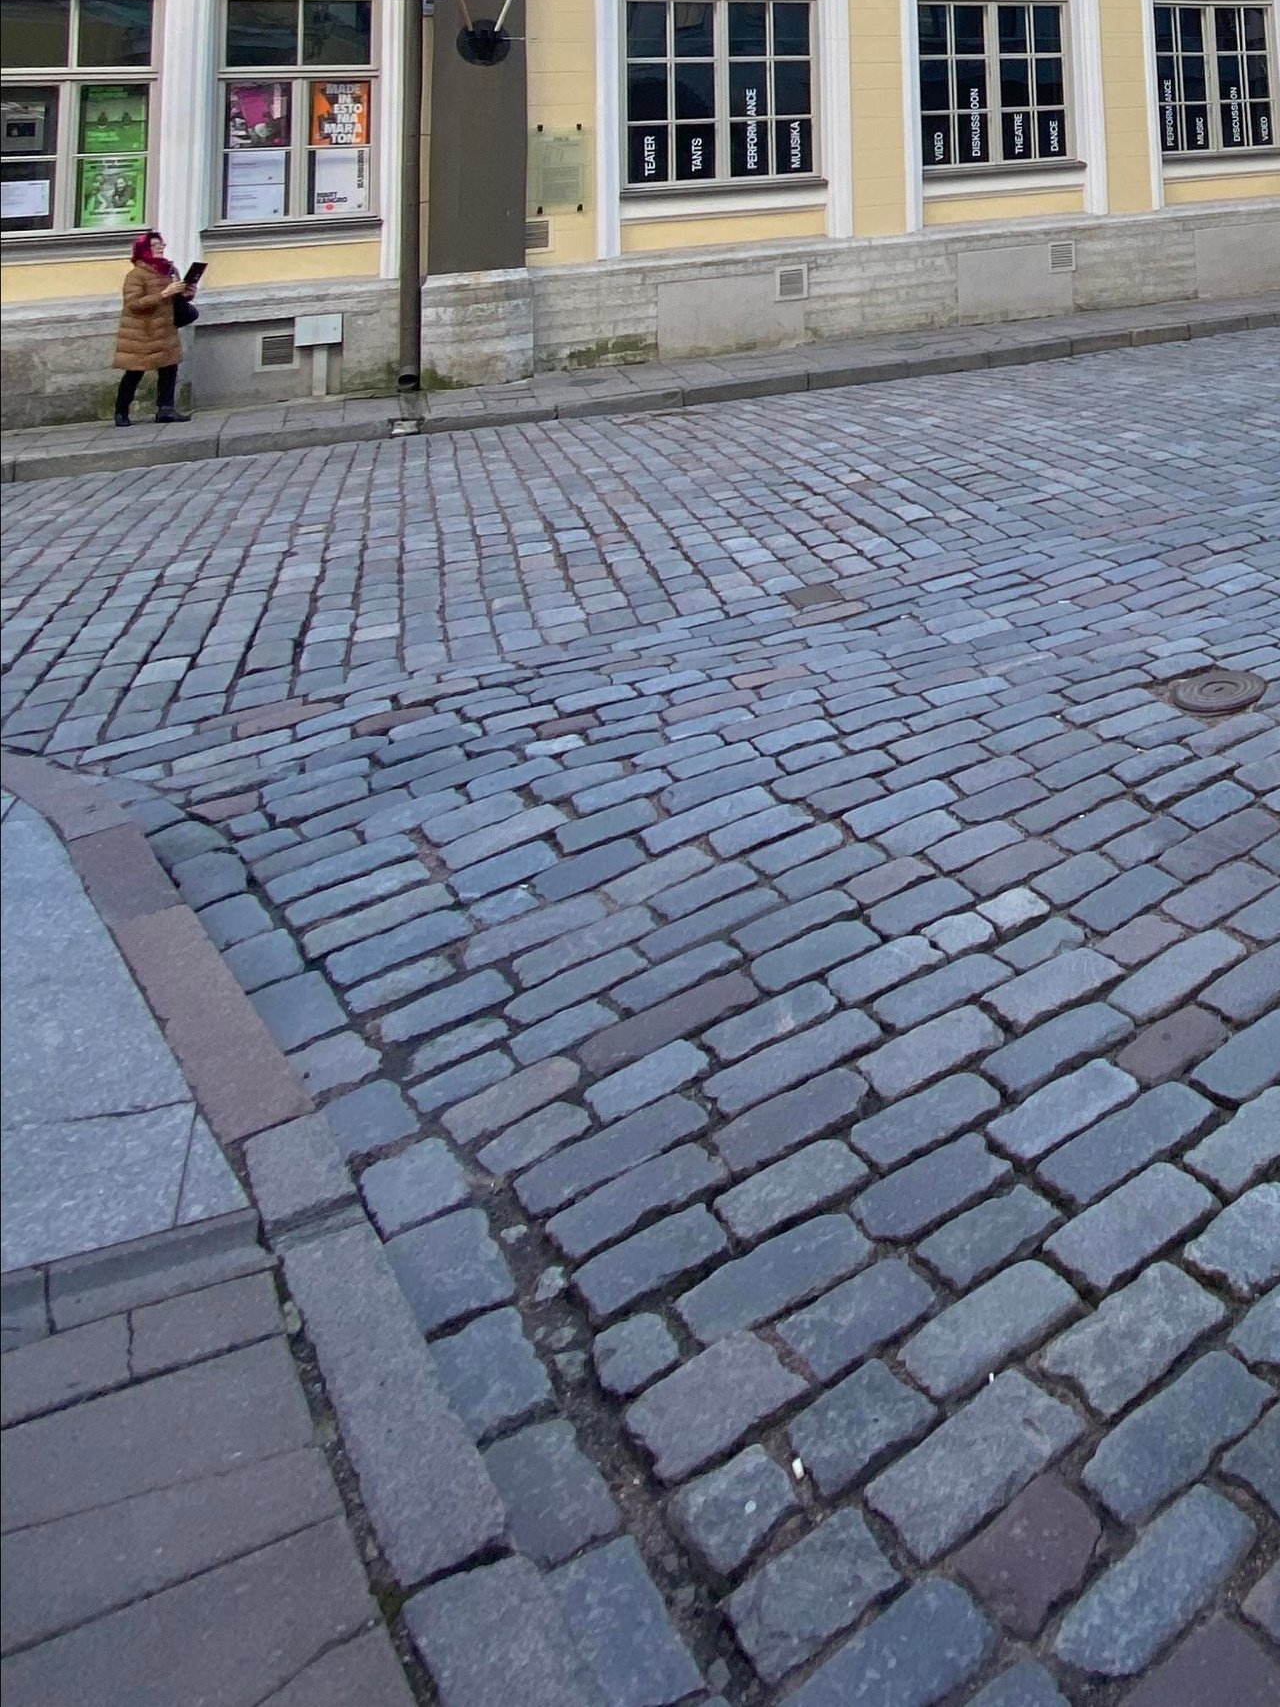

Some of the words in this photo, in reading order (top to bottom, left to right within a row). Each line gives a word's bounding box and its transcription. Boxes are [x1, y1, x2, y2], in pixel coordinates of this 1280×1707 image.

[326, 84, 361, 94] MADE
[338, 94, 352, 104] IN
[334, 103, 363, 114] ESTO
[970, 88, 981, 157] DISKUSSIOON
[1163, 79, 1174, 147] PERFORMANCE
[1229, 86, 1241, 142] DISCUSSION
[745, 88, 758, 170] PERFORMANCE
[790, 121, 801, 169] MUUSIKA
[934, 131, 944, 161] VIDEO
[1014, 113, 1024, 154] THEATRE
[1049, 120, 1059, 152] DANCE
[1195, 117, 1205, 145] MUSIC
[1259, 116, 1269, 141] VIDEO
[644, 135, 656, 176] TEATER
[691, 137, 703, 172] TANTS
